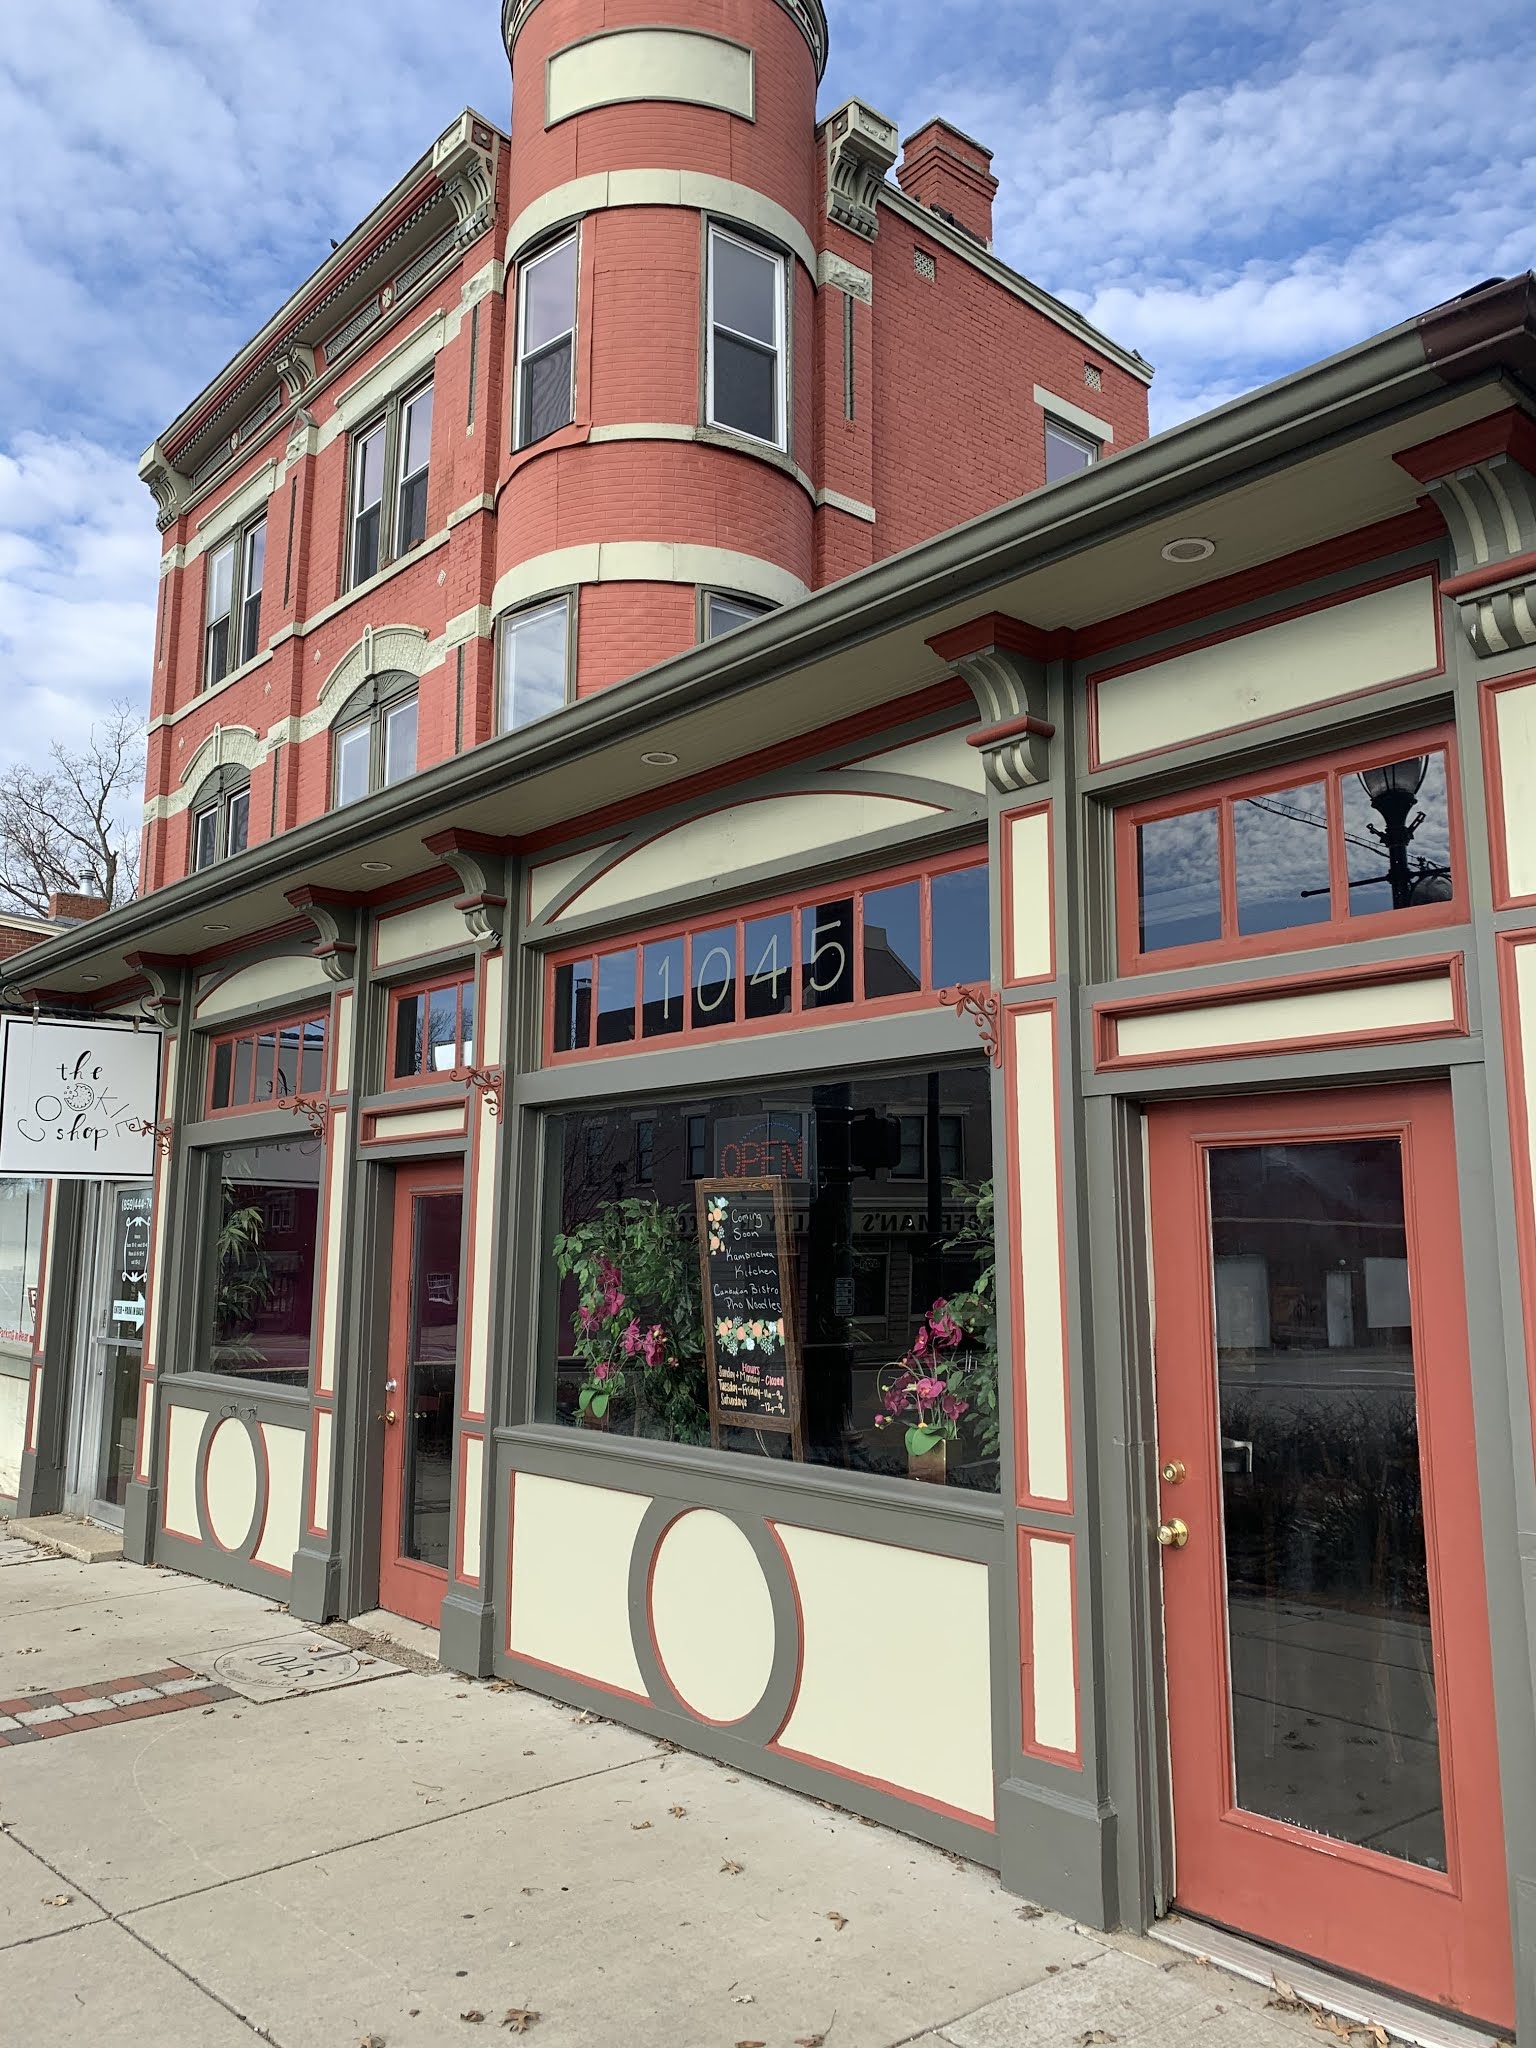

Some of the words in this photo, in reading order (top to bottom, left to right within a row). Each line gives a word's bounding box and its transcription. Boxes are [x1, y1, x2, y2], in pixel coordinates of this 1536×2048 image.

[658, 920, 846, 1019] 1045
[56, 1050, 103, 1081] the
[56, 1113, 109, 1151] shop
[721, 1136, 803, 1178] OPEN
[731, 1209, 763, 1228] Coming
[733, 1228, 760, 1240] Soon
[735, 1265, 777, 1278] Kitchen
[749, 1283, 779, 1295] Bistro
[724, 1297, 743, 1309] Pho
[746, 1298, 783, 1313] Noodles
[718, 1365, 735, 1381] Sunday
[740, 1371, 760, 1386] Monday
[765, 1375, 784, 1387] Closed
[742, 1362, 760, 1375] Hours
[245, 1652, 327, 1678] 1045
